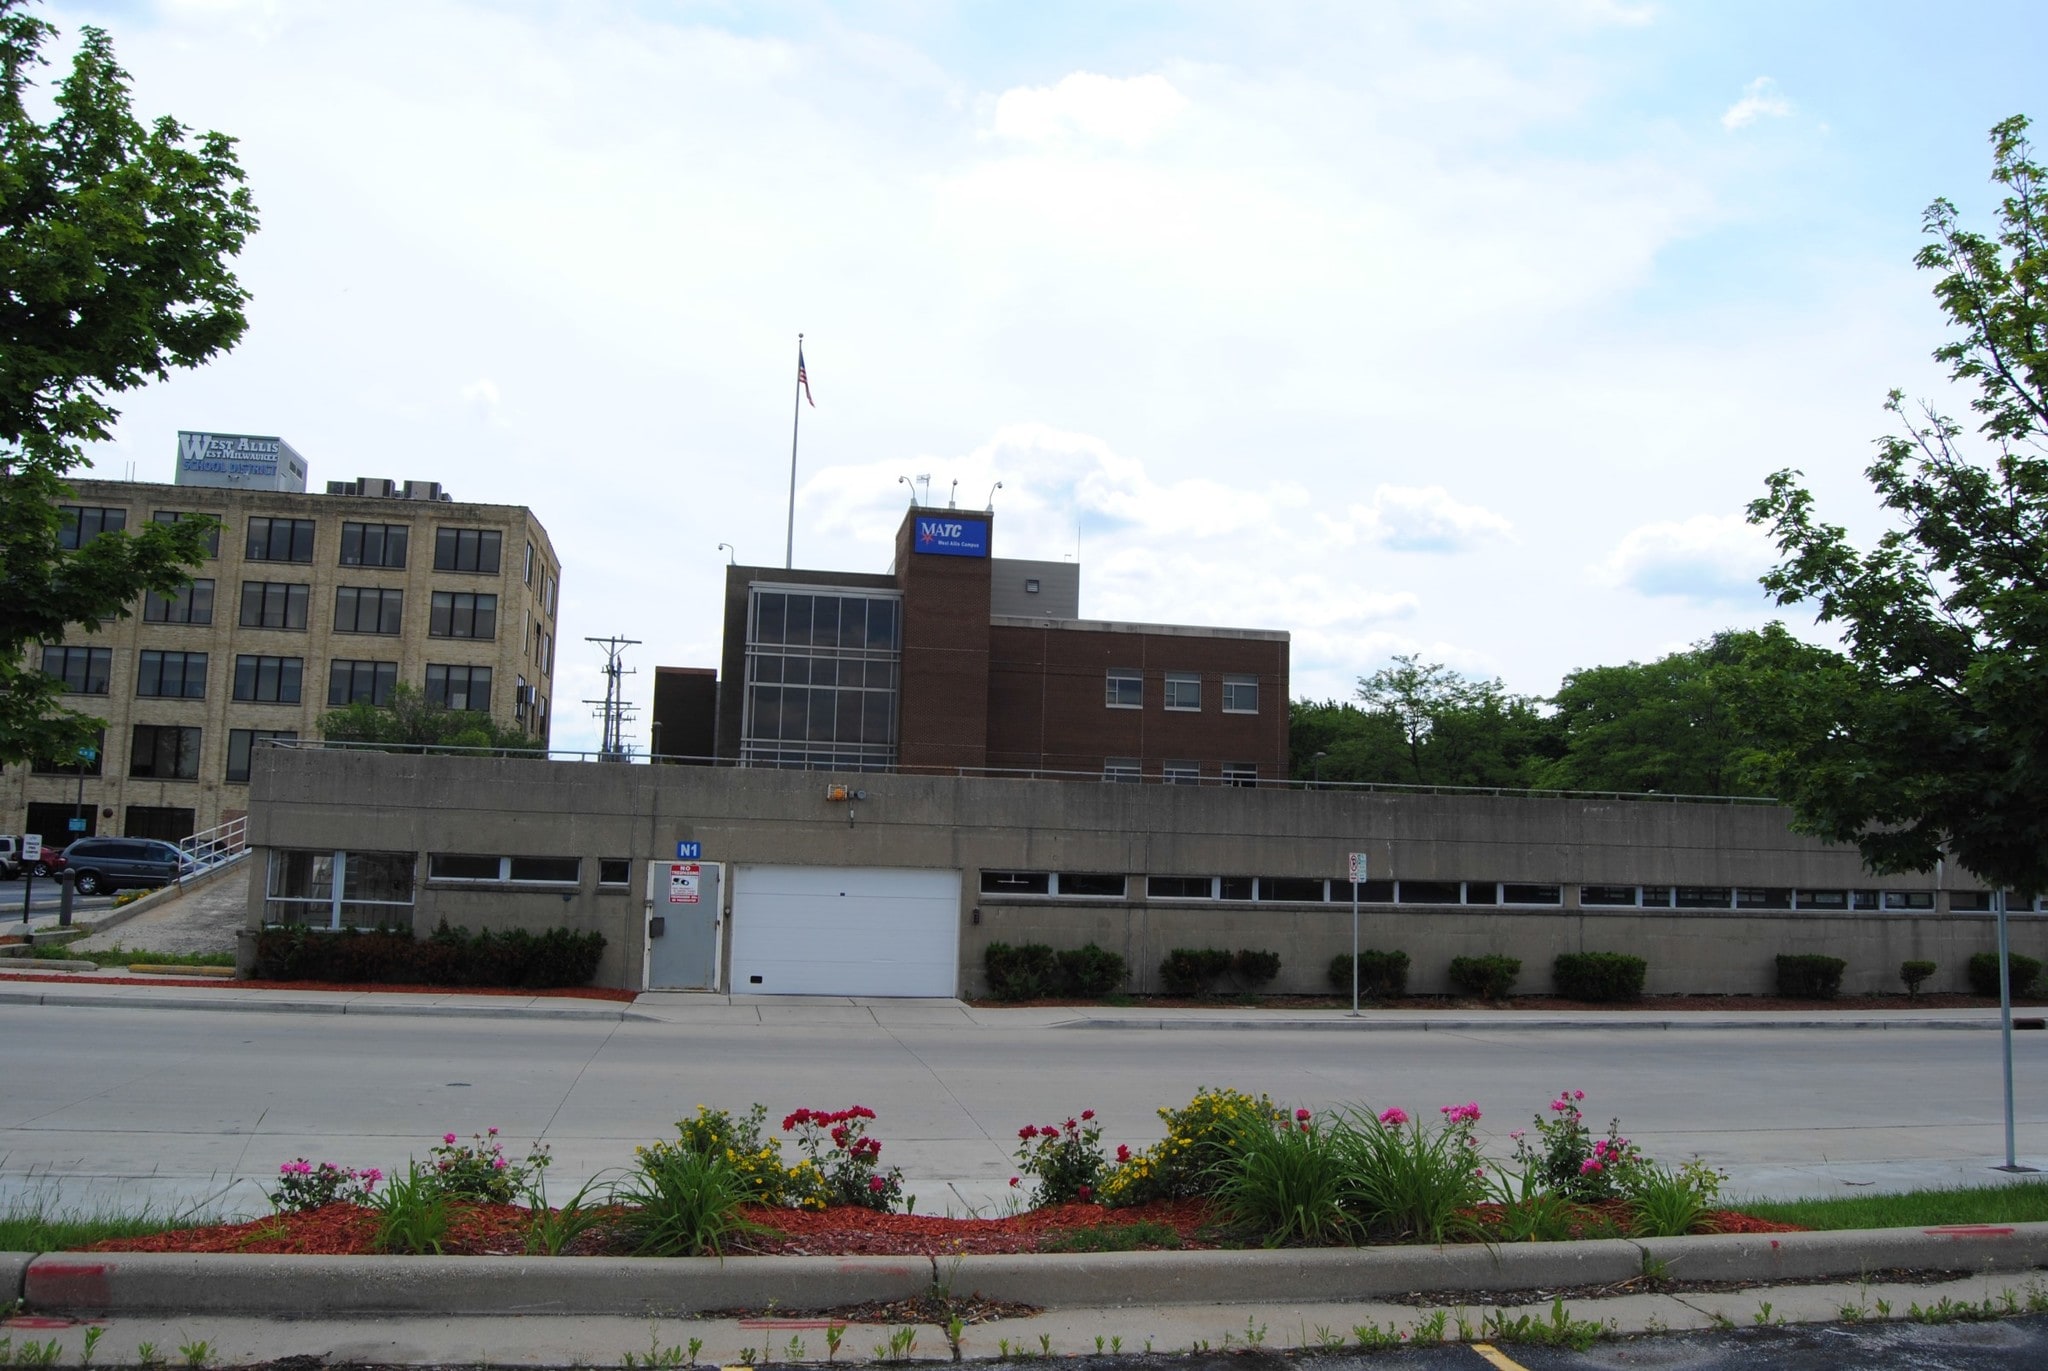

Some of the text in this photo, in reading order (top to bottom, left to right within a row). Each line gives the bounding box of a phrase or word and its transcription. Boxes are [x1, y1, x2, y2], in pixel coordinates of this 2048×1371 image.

[237, 438, 279, 453] ALLIS
[182, 461, 278, 476] SCHOOL DISTRICT
[921, 522, 962, 538] MATC
[680, 843, 697, 857] N1
